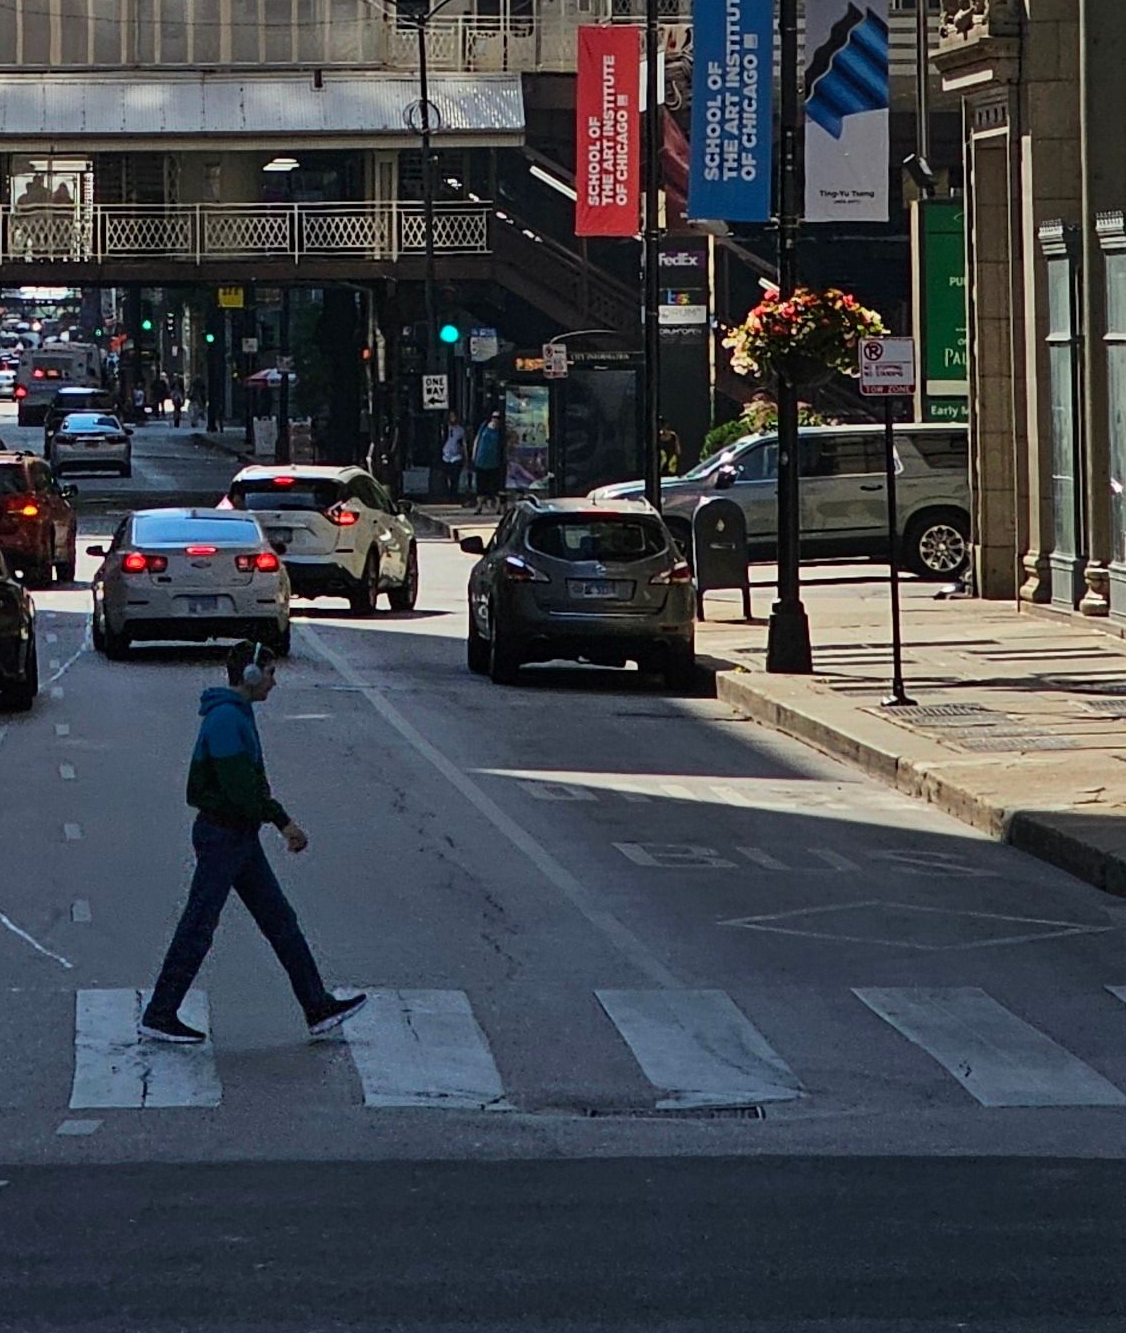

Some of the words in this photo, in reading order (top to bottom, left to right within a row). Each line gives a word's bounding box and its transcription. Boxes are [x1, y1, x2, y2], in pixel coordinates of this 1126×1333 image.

[707, 61, 723, 90] OF
[603, 55, 616, 137] INSTITUTE
[742, 54, 758, 148] CHICAGO
[588, 116, 601, 137] OF
[724, 92, 740, 134] ART
[616, 110, 628, 182] CHICAGO
[704, 94, 722, 181] SCHOOL
[602, 139, 615, 171] ART
[723, 138, 738, 181] THE
[741, 154, 757, 181] OF
[588, 140, 601, 206] SCHOOL
[602, 173, 614, 206] THE
[616, 185, 628, 206] OF
[658, 252, 699, 267] FedEx
[426, 377, 444, 386] ONE
[426, 386, 445, 395] WAY
[865, 385, 883, 394] TOW
[888, 385, 912, 394] ZONE
[930, 405, 958, 417] Early
[610, 841, 1000, 878] BUS
